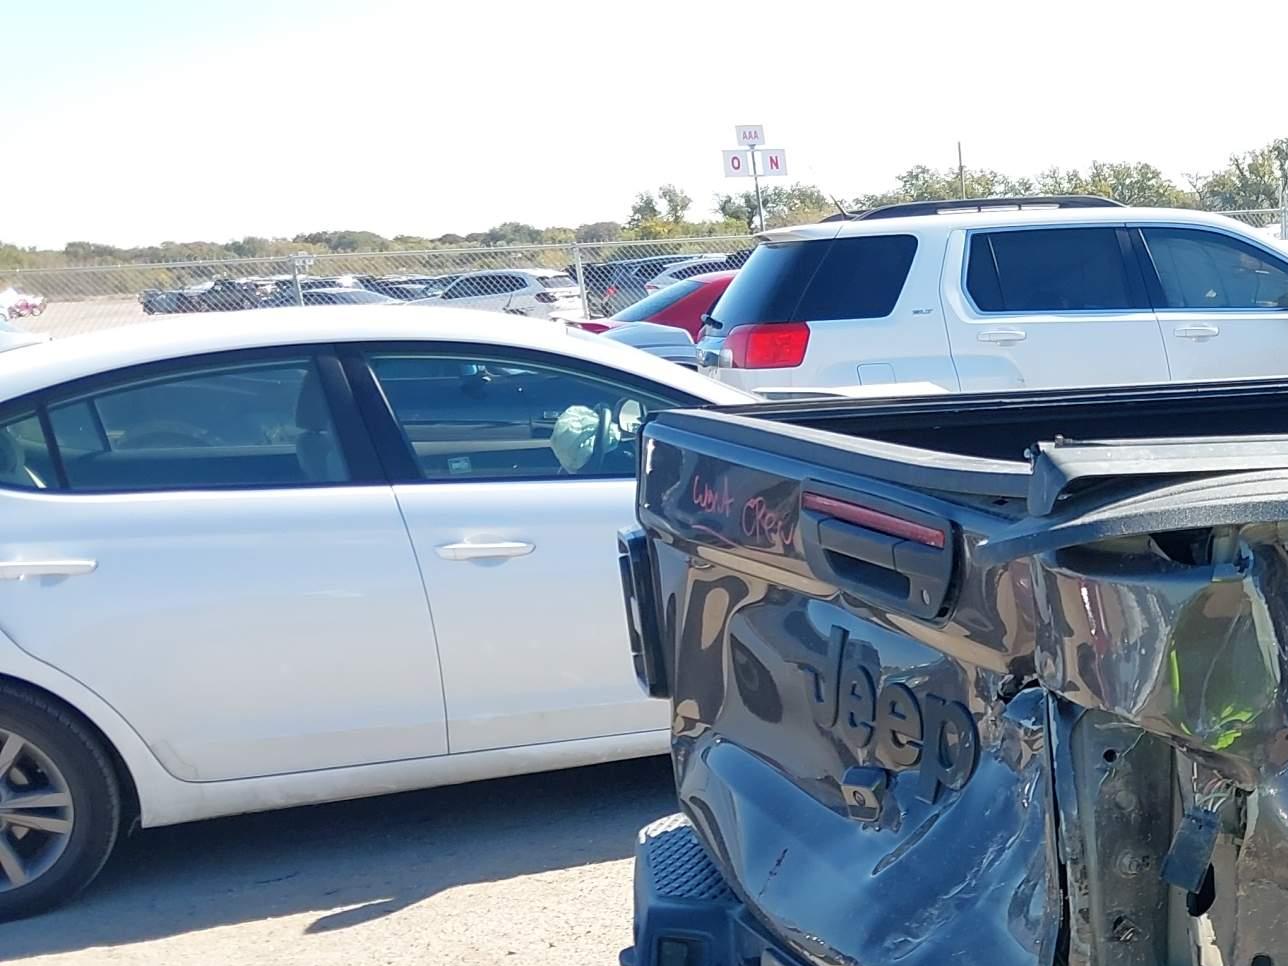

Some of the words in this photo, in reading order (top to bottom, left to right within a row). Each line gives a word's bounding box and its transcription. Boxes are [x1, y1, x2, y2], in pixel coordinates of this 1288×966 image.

[742, 130, 760, 141] AAA
[769, 155, 780, 170] N
[800, 624, 982, 805] Jeep
